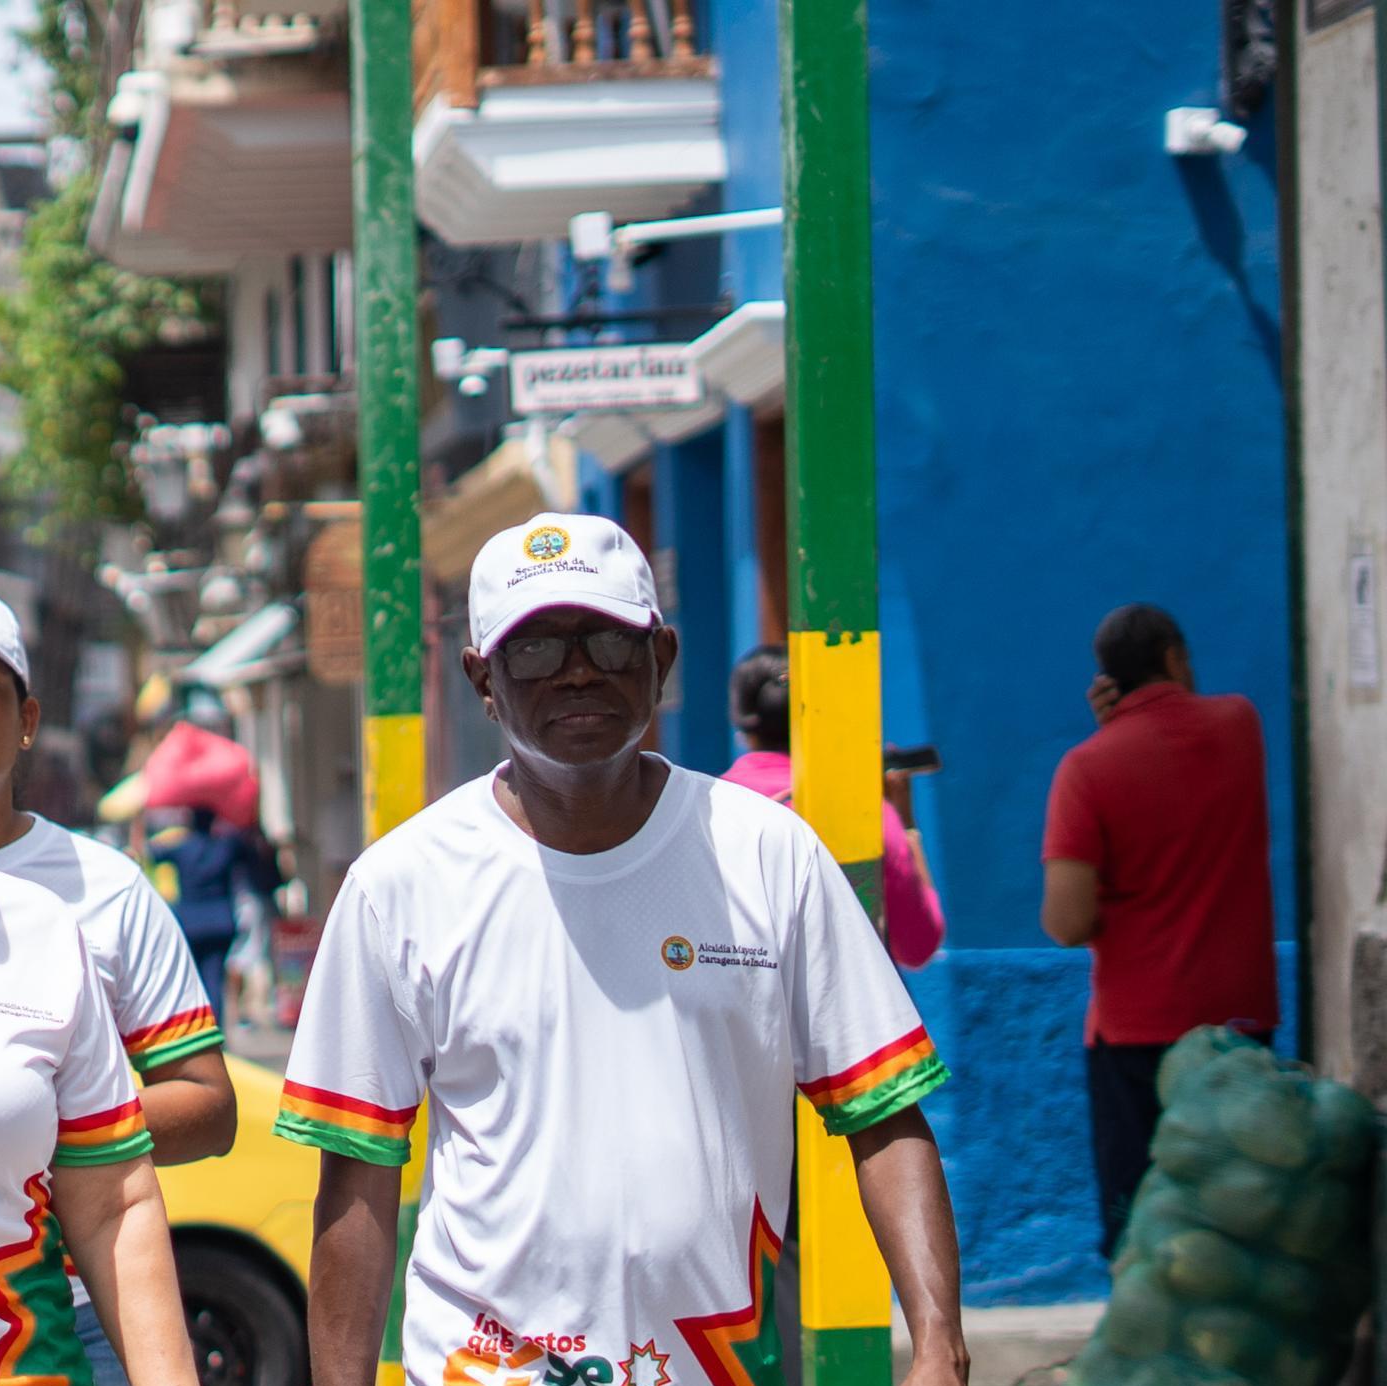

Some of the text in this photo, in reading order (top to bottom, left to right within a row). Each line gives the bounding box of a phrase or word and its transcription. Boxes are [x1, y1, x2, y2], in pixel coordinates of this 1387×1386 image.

[572, 557, 584, 565] de
[698, 942, 768, 956] Alcaldía Mayor de
[698, 955, 741, 967] Cartagena
[750, 958, 778, 969] Indias
[467, 1333, 514, 1355] que
